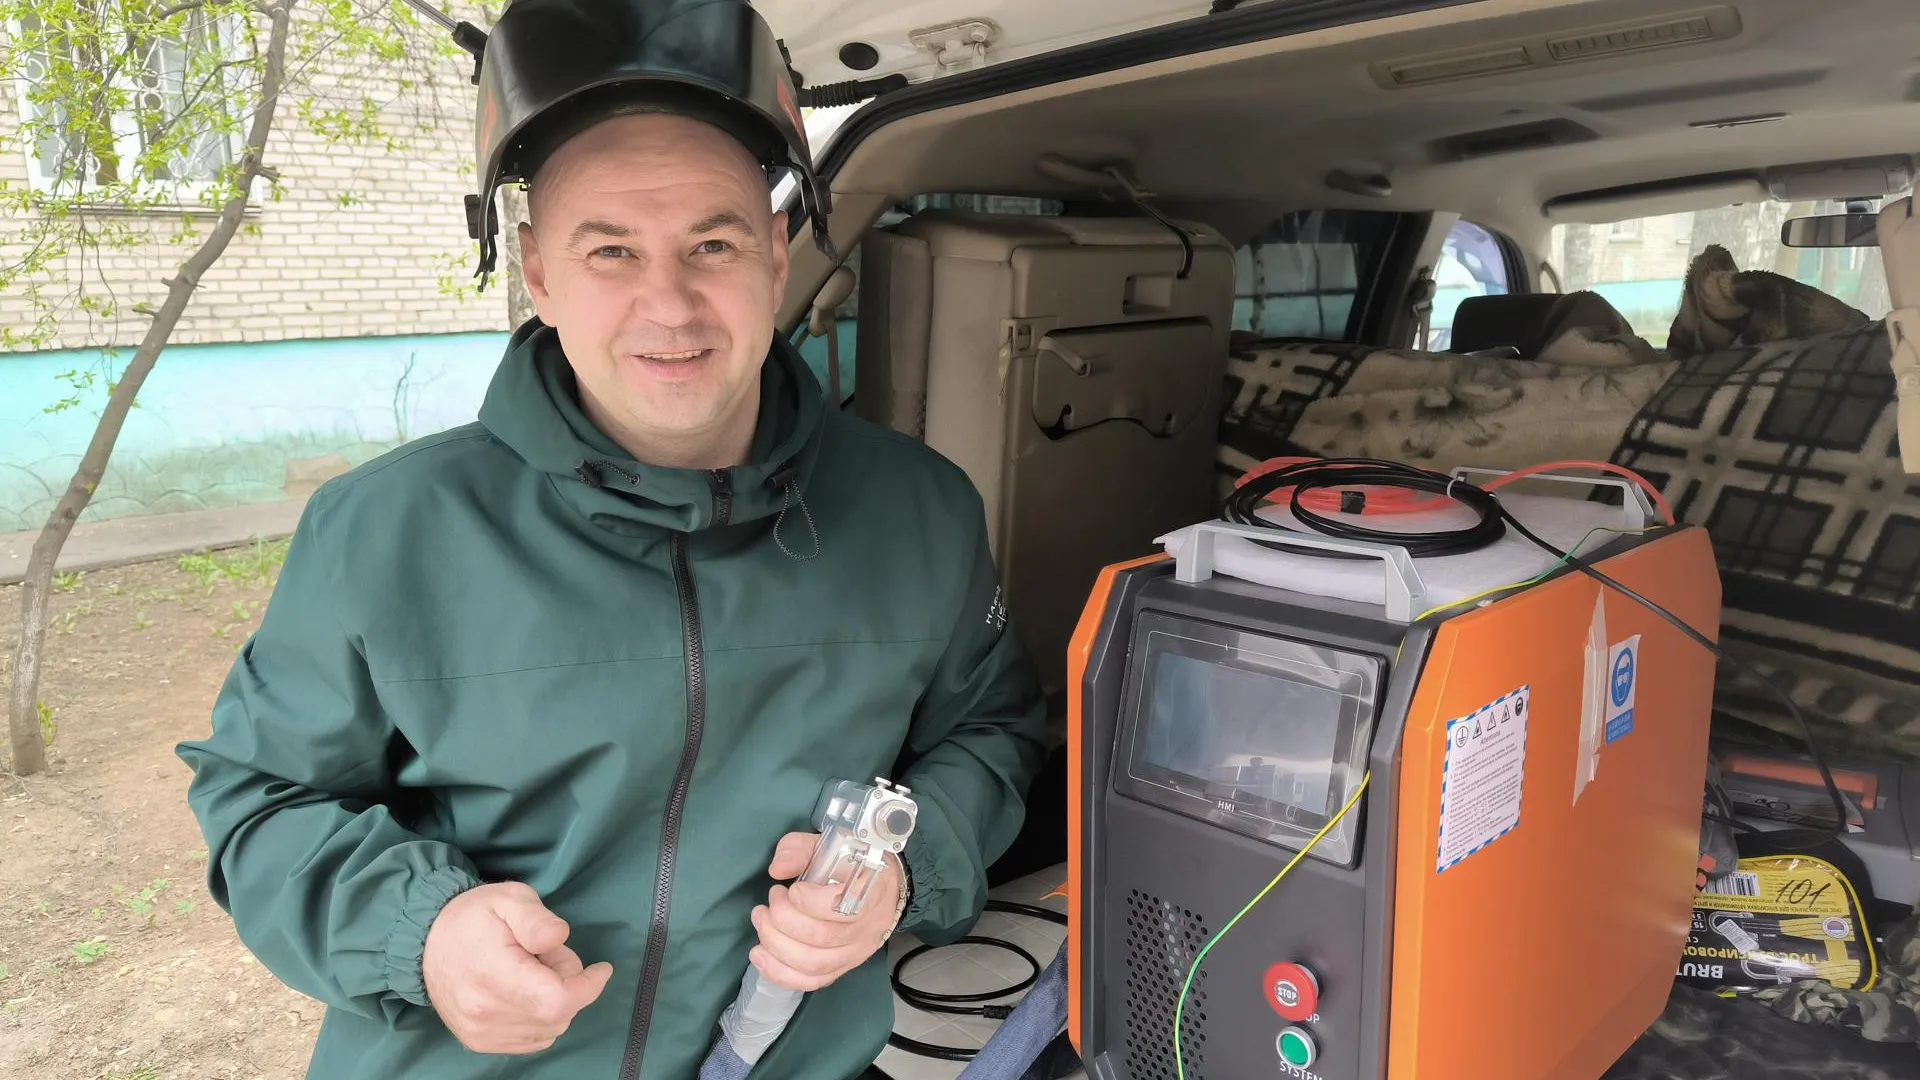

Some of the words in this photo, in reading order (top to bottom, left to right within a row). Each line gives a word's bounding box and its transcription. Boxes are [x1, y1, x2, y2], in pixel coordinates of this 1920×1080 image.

[1218, 800, 1235, 812] HMI
[1776, 879, 1831, 908] 101
[1278, 987, 1297, 1000] STOP
